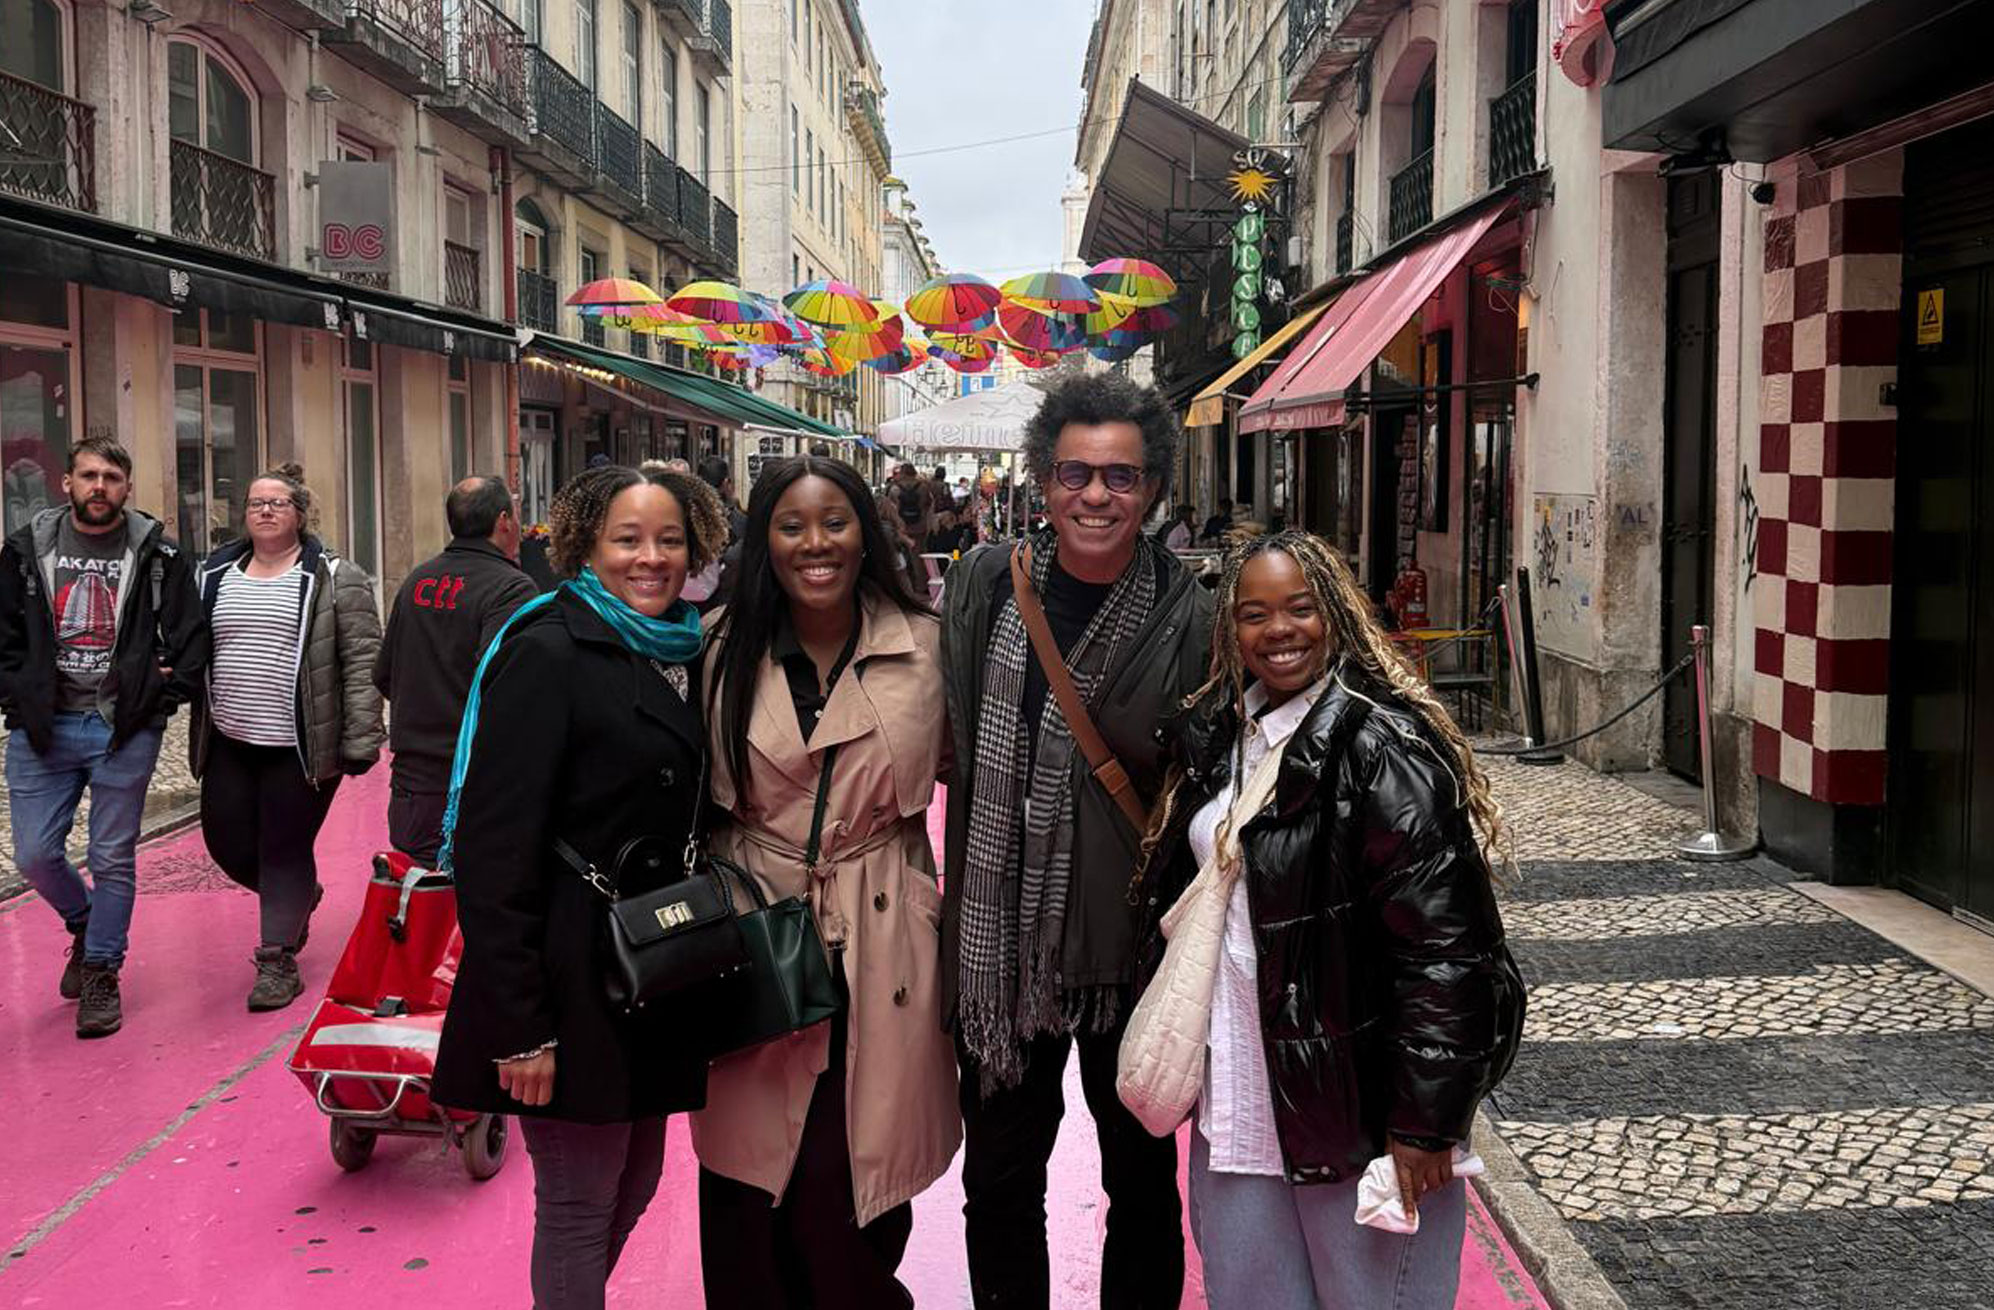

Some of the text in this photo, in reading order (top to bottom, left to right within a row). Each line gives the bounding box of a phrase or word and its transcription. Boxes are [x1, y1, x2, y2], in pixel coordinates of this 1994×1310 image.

[1232, 149, 1267, 171] SOL
[324, 224, 384, 260] BC
[903, 420, 1026, 447] Heine
[414, 576, 464, 610] ctt
